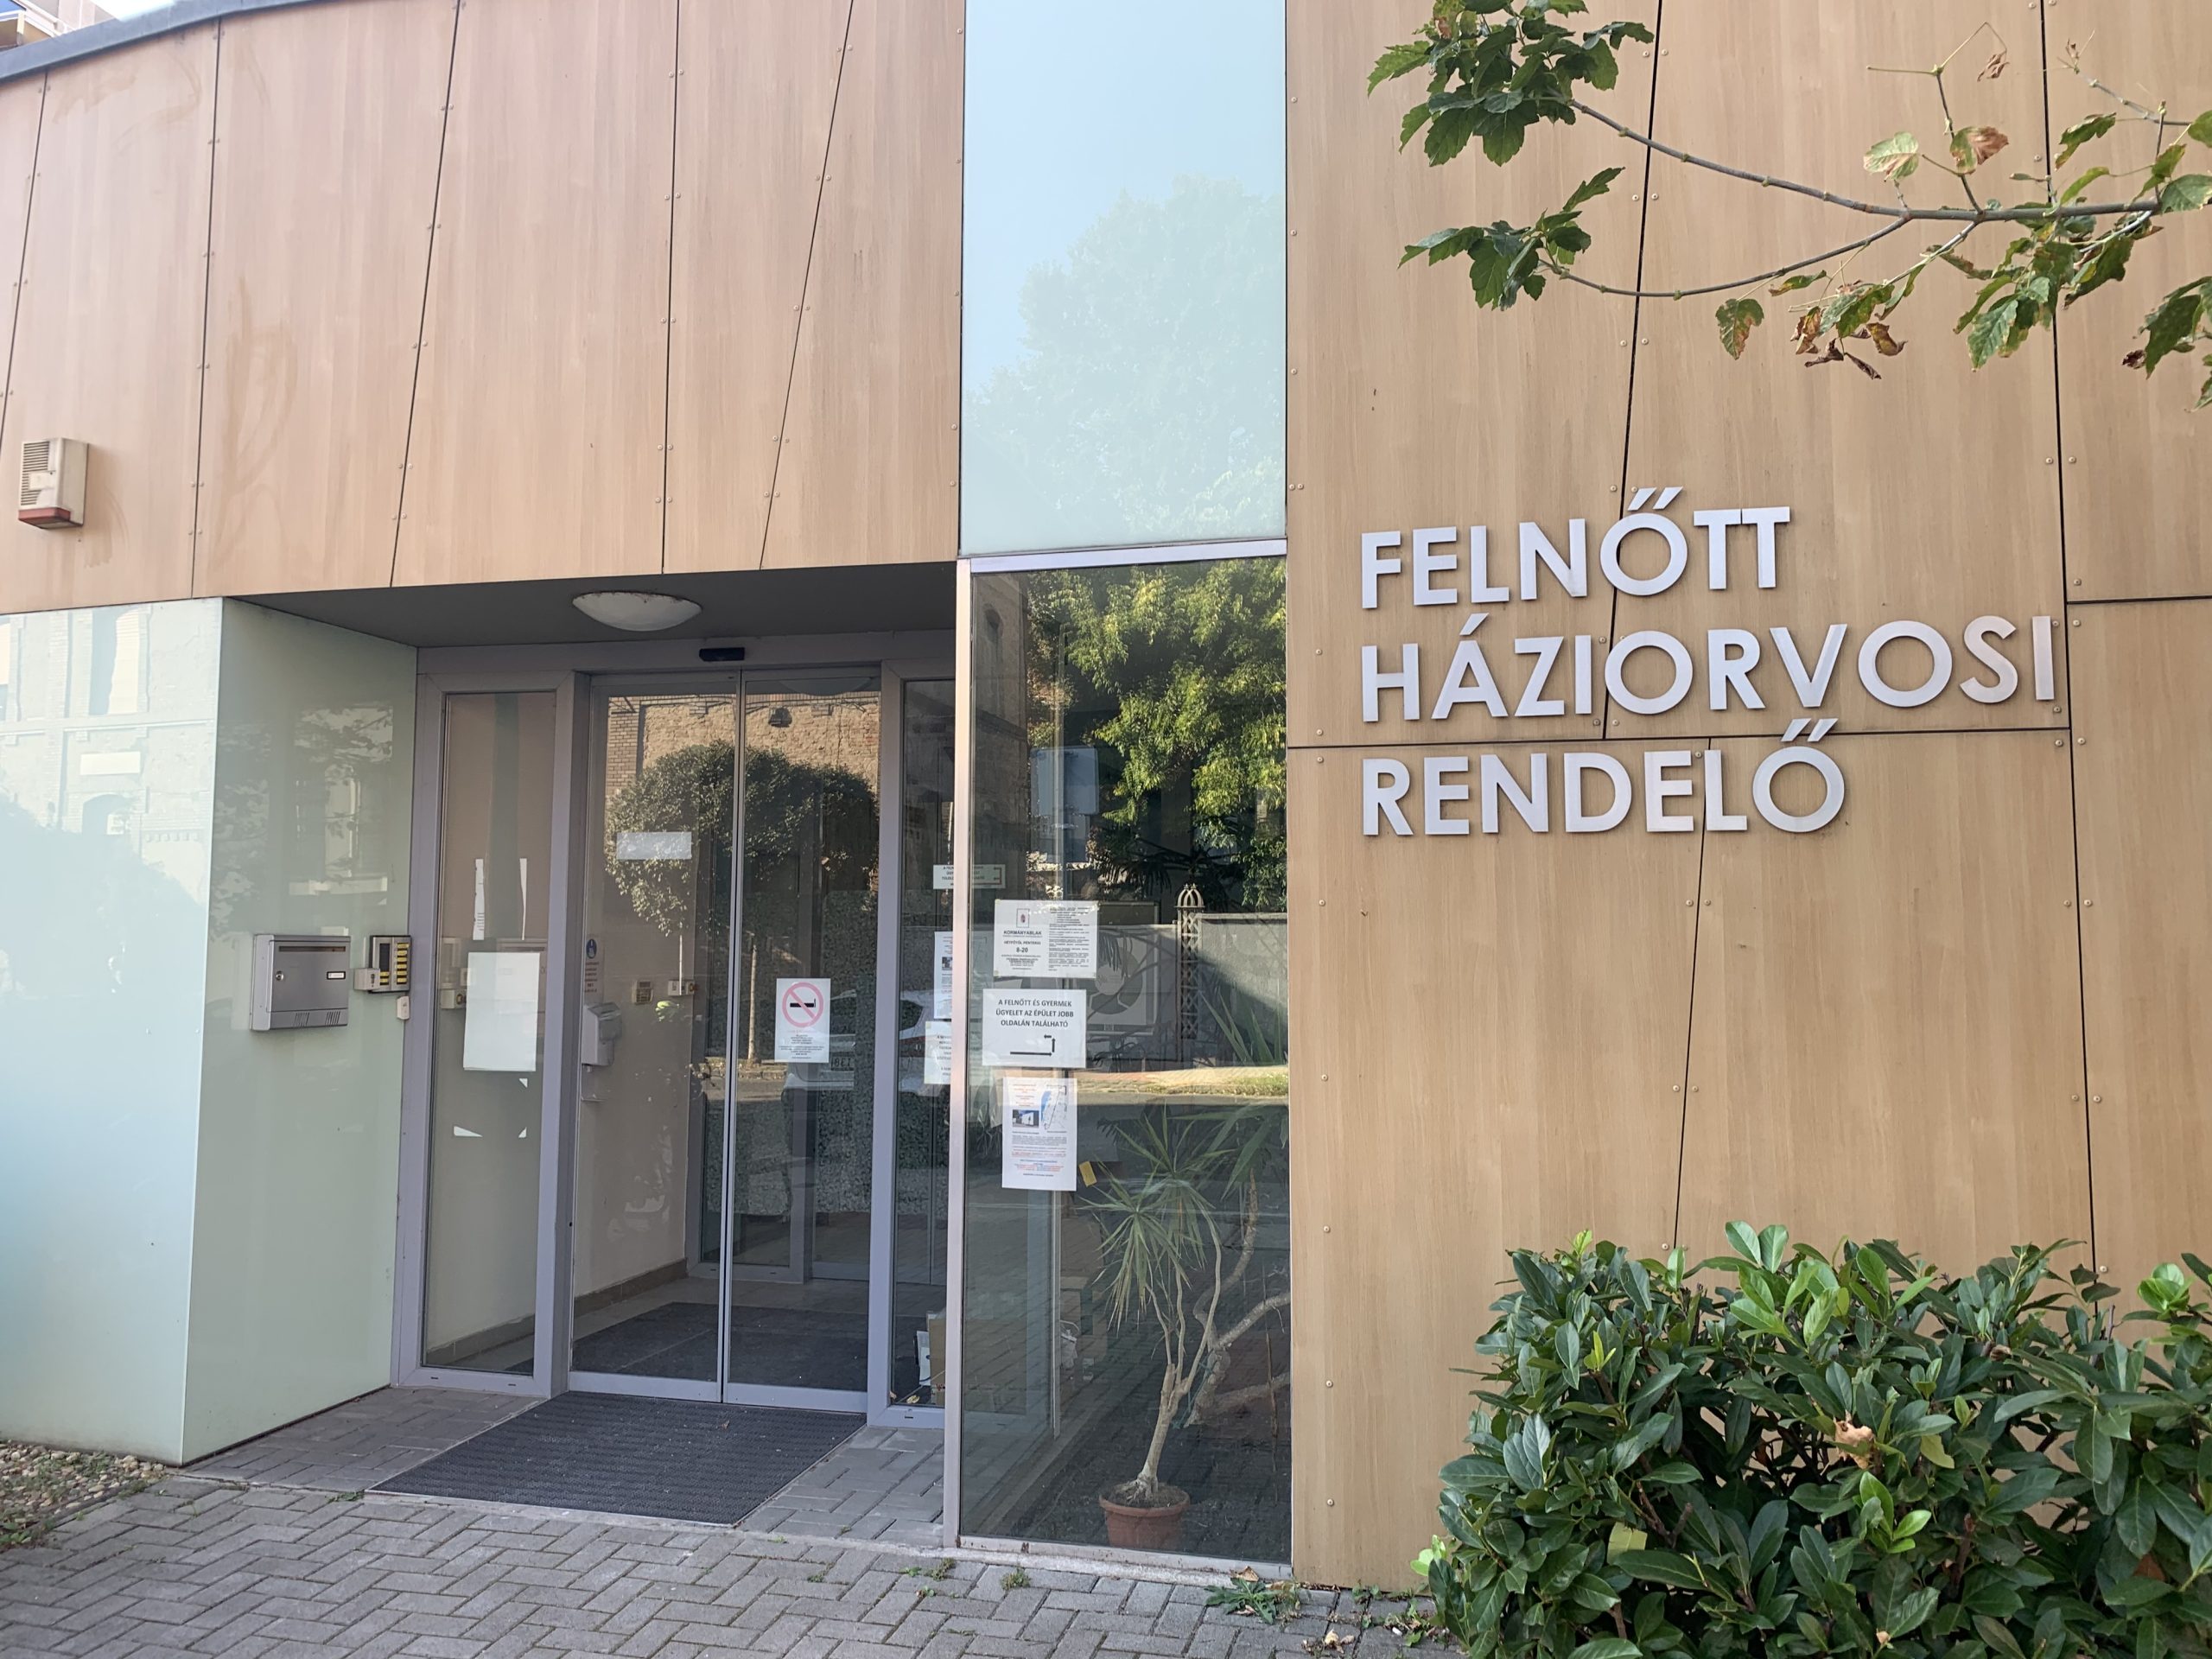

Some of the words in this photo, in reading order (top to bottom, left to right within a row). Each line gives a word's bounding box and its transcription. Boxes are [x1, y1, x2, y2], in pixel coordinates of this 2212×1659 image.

[1361, 486, 1791, 609] FELNŐTT
[1362, 613, 2055, 722] HÁZIORVOSI
[1363, 718, 1845, 836] RENDELŐ
[995, 1007, 1023, 1016] ÜGYELET
[1033, 1008, 1057, 1017] ÉPÜLET
